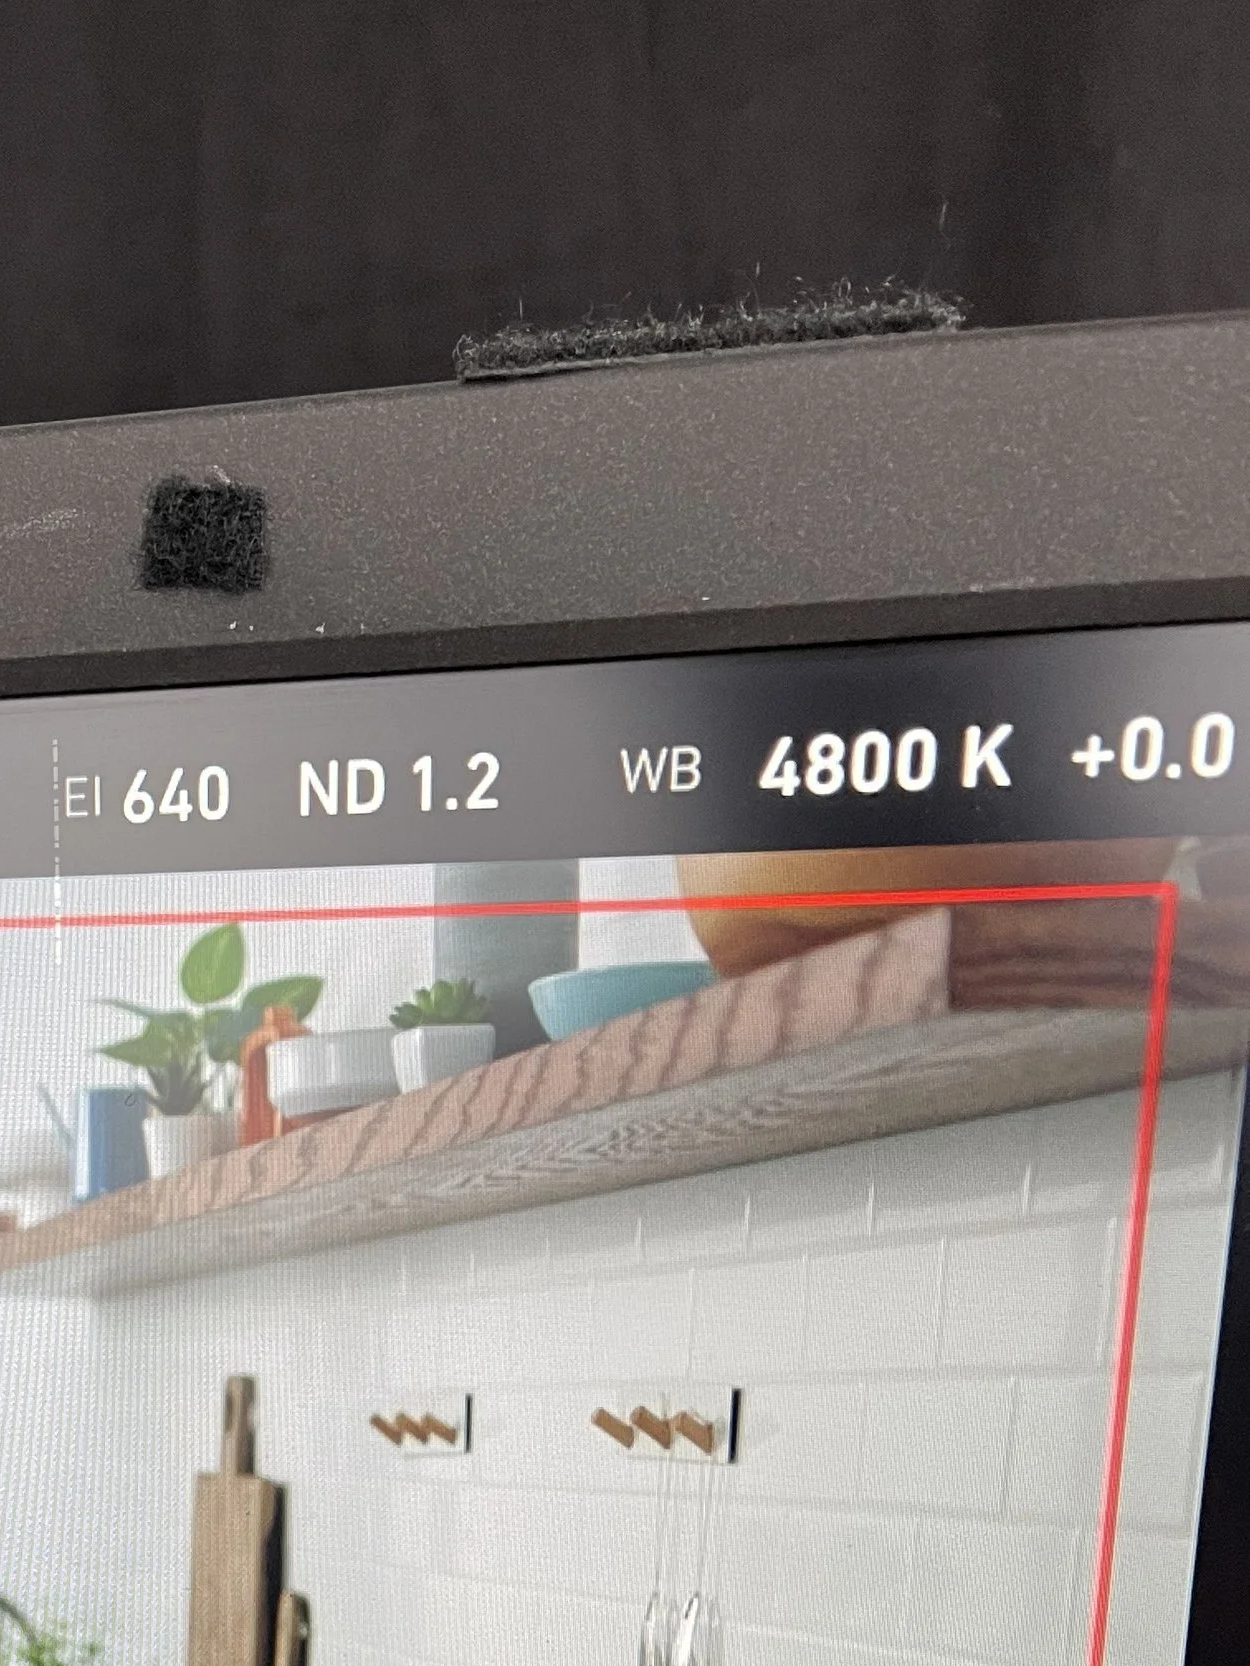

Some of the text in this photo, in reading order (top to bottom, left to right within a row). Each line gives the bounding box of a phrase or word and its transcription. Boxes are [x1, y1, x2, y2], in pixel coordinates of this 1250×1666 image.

[299, 752, 501, 817] ND 1.2
[621, 711, 1237, 797] WB 4800 K +0.0
[65, 765, 231, 824] EI 640
